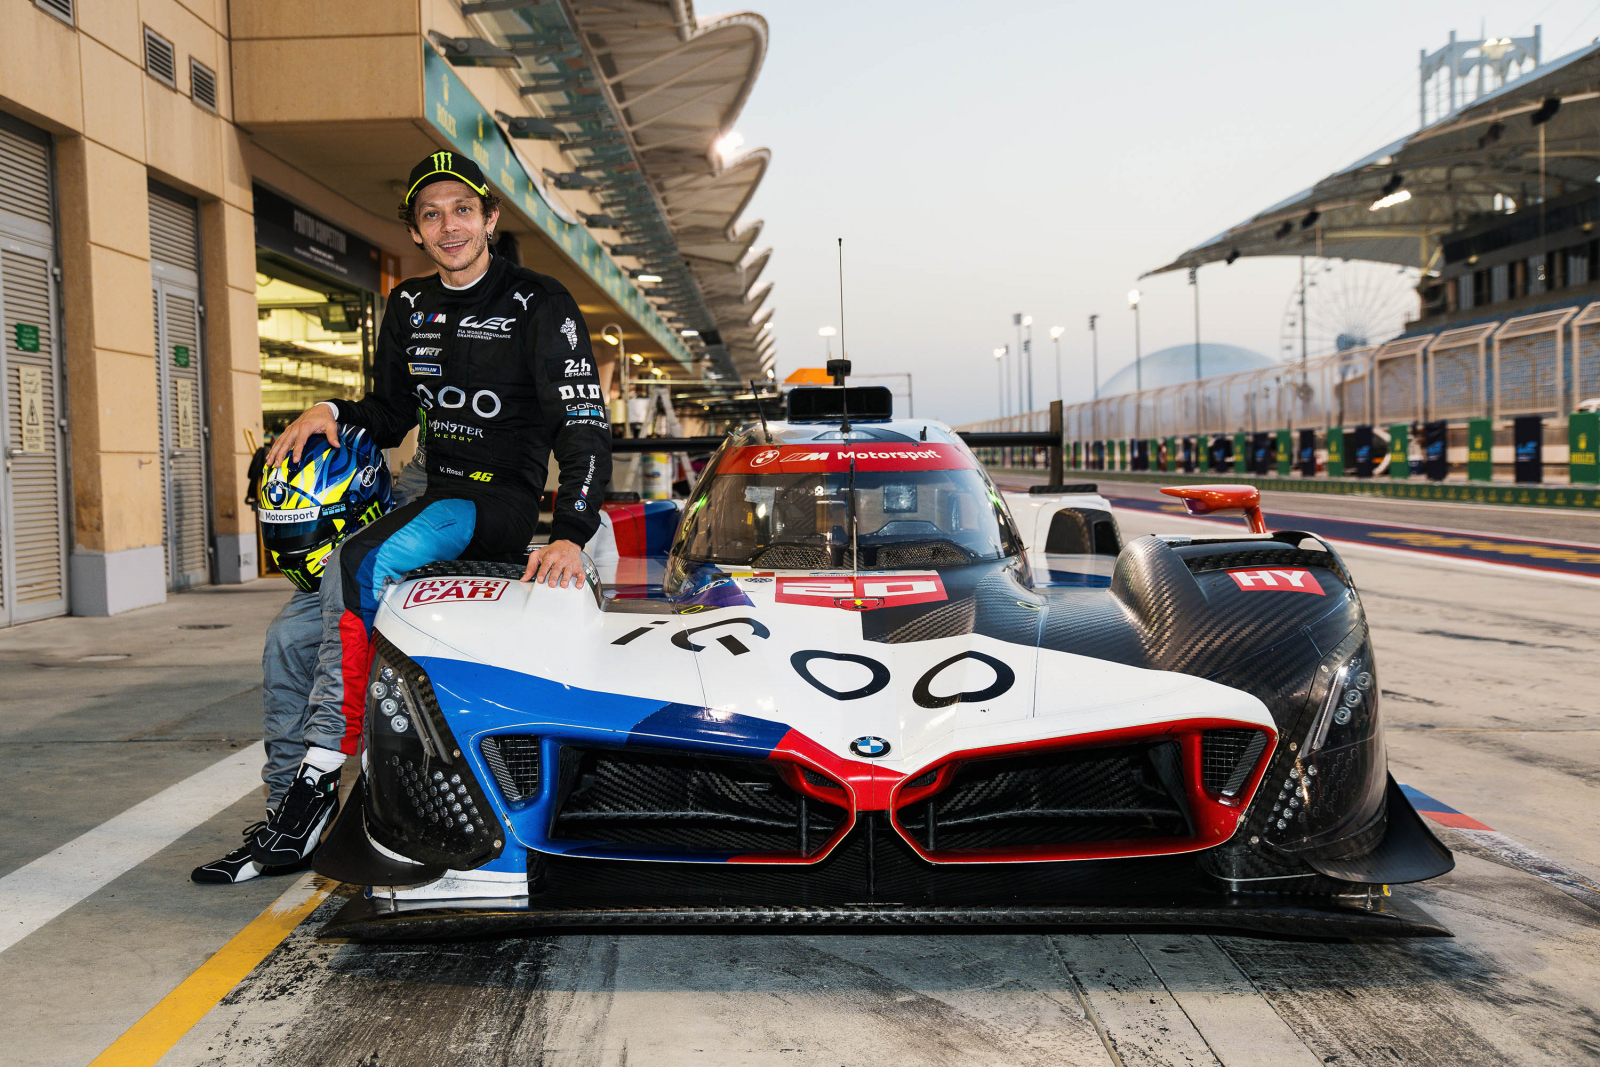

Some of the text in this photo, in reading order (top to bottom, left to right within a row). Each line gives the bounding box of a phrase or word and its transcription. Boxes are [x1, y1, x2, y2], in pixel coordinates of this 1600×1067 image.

[459, 315, 517, 332] WEC
[415, 347, 443, 357] WRT
[837, 449, 942, 461] Motorsport
[446, 467, 464, 477] Rossi
[468, 471, 494, 483] 46
[265, 510, 315, 523] Motorsport
[419, 580, 501, 590] HYPER
[1232, 570, 1306, 588] HY
[412, 586, 496, 603] CAR
[782, 580, 938, 598] 20
